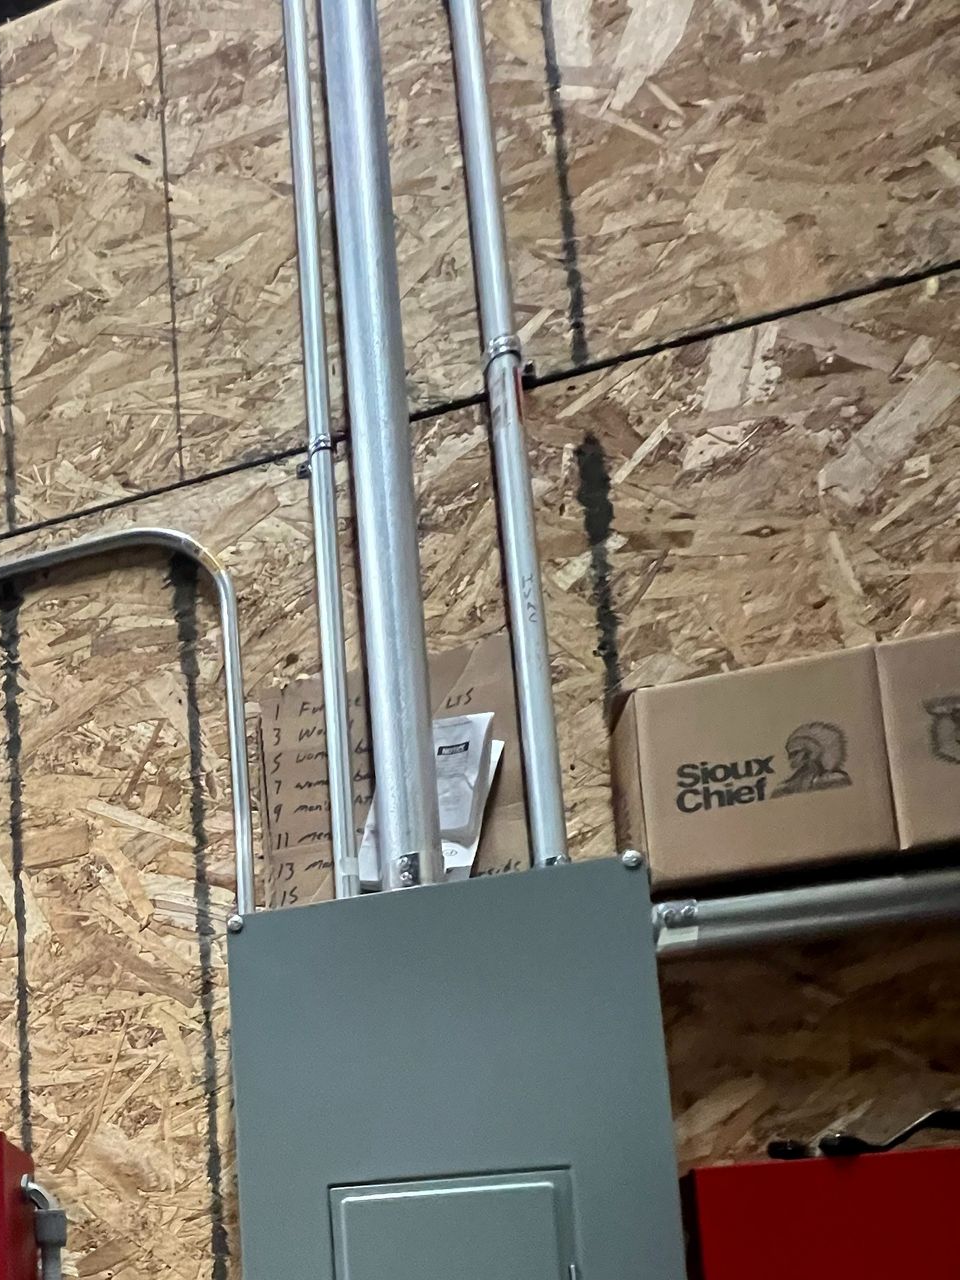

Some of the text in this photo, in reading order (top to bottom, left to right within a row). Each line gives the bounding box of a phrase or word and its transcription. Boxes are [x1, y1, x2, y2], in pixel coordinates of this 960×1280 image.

[521, 573, 537, 623] HVAC
[272, 727, 282, 747] 3
[270, 752, 283, 775] 5
[676, 755, 775, 789] Sioux
[273, 780, 282, 796] 7
[675, 777, 768, 814] Chief
[273, 802, 284, 824] 9
[276, 831, 290, 851] 11
[277, 862, 295, 881] 13
[280, 886, 299, 908] 15
